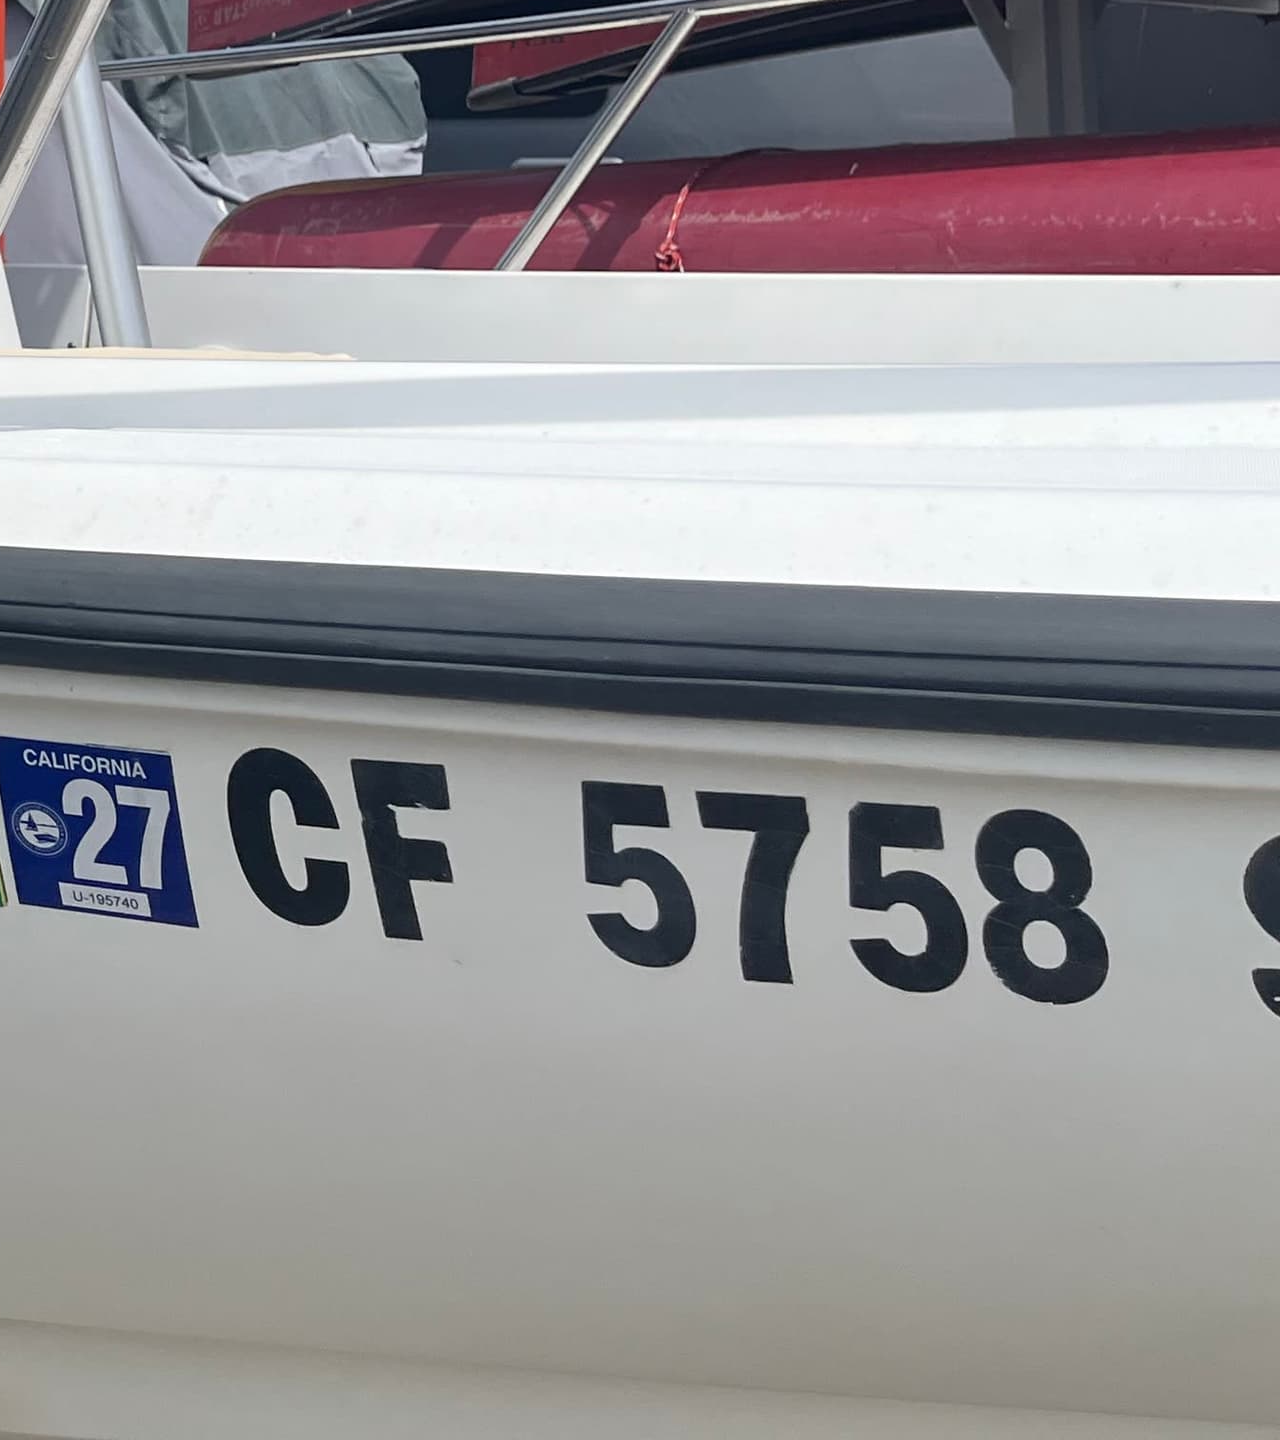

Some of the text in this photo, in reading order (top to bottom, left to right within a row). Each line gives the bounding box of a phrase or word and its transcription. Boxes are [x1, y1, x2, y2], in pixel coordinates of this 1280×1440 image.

[22, 748, 147, 780] CALIFORNIA
[61, 778, 171, 891] 27
[72, 890, 139, 910] U-195740
[226, 746, 454, 941] CF
[580, 778, 1110, 1006] 5758
